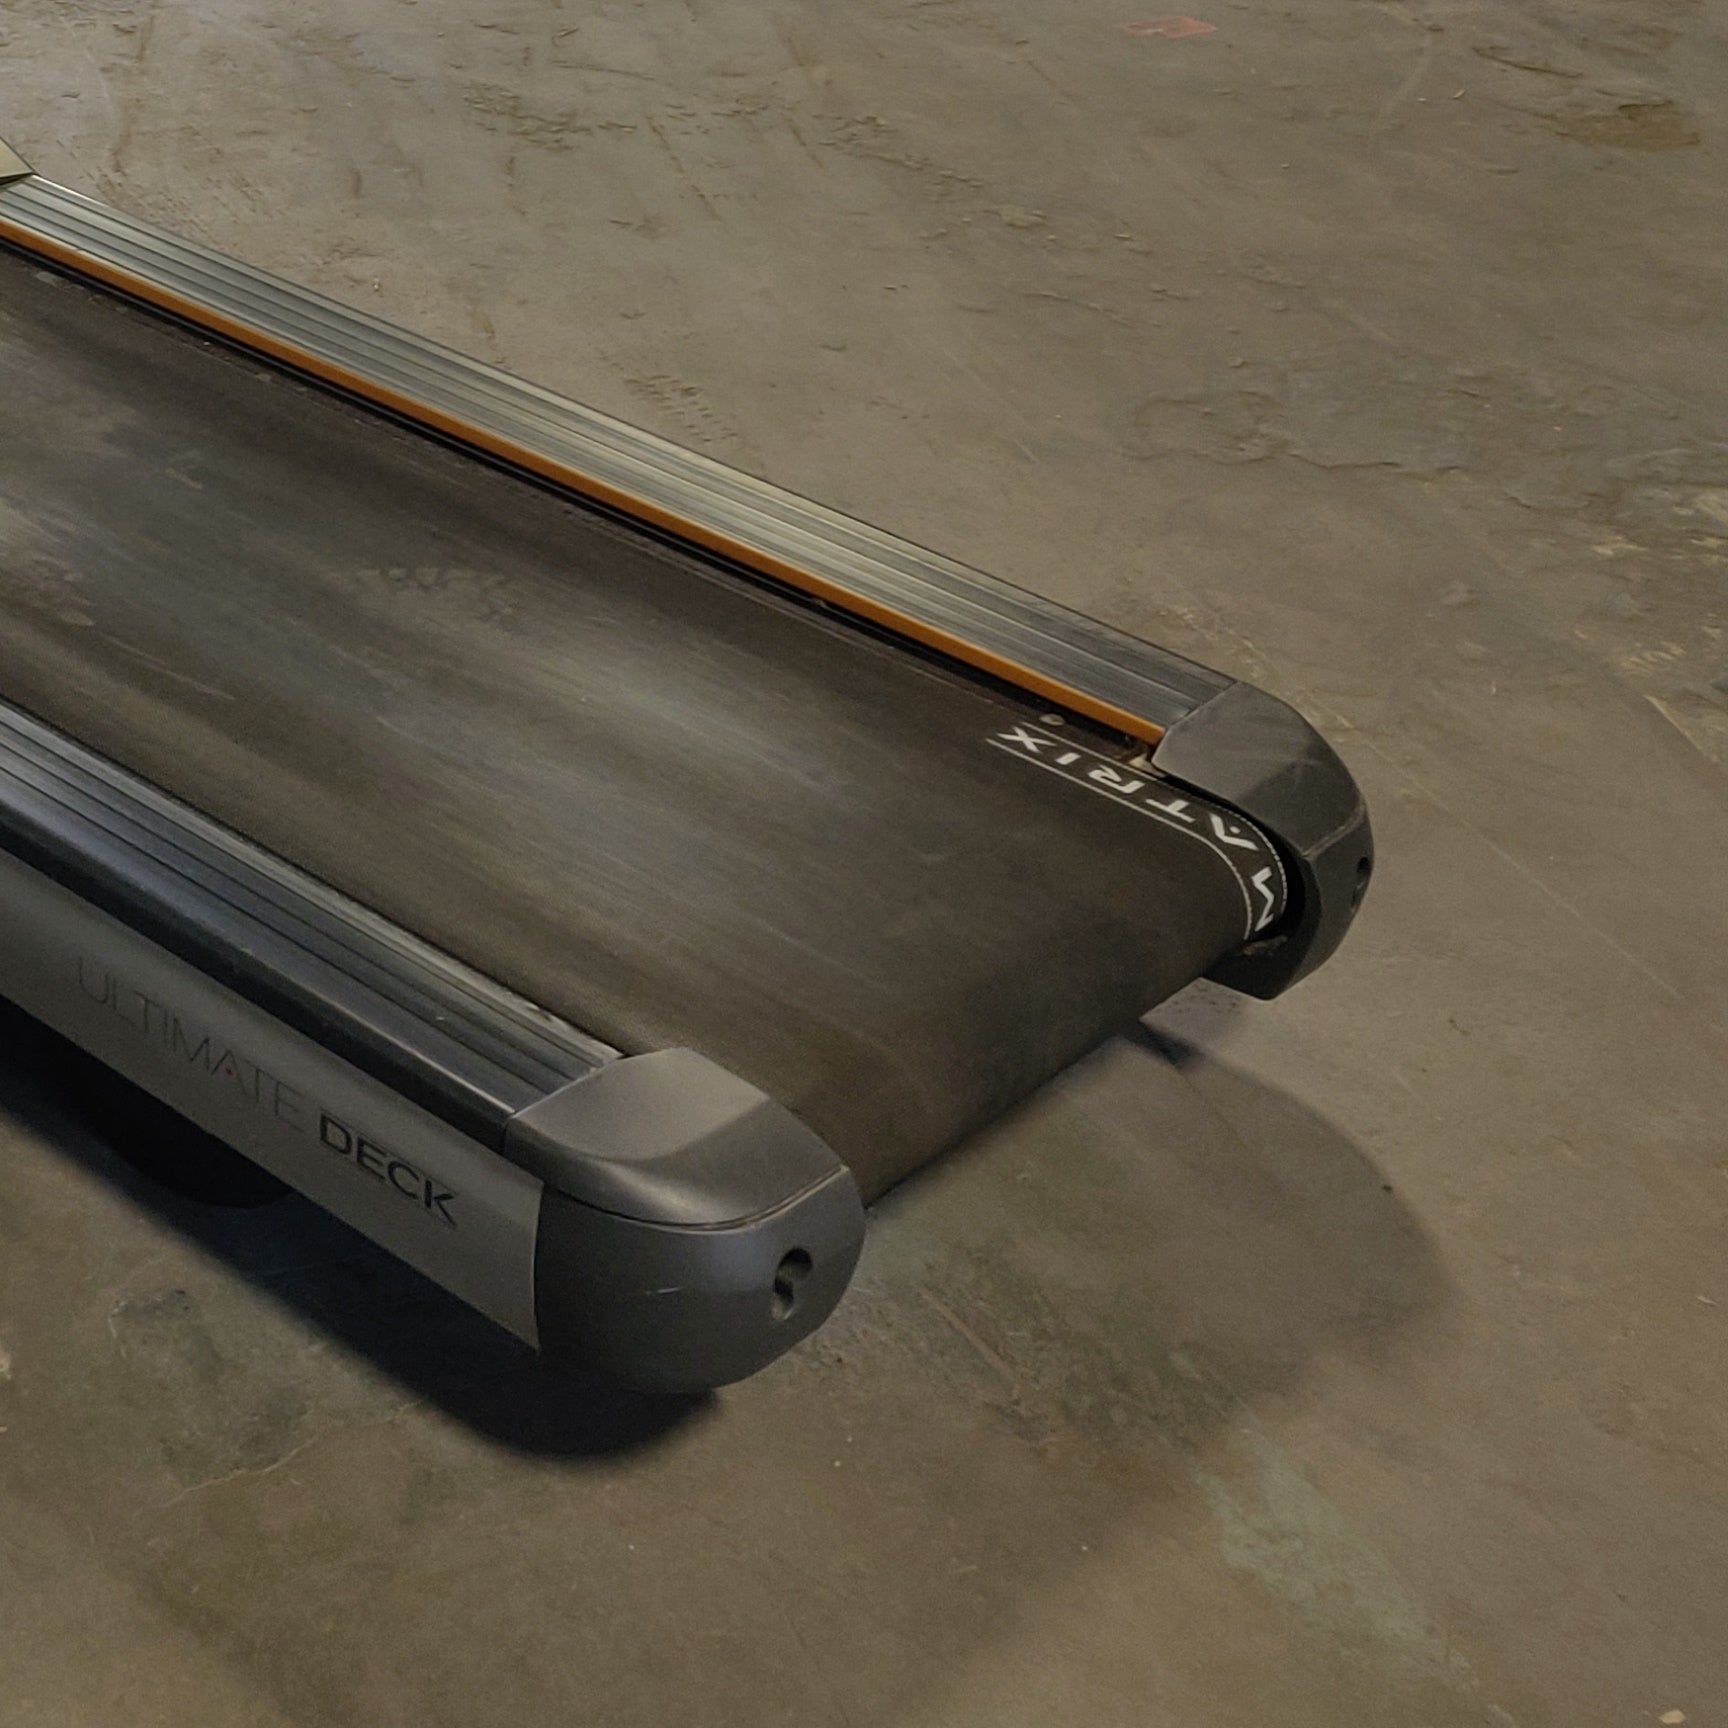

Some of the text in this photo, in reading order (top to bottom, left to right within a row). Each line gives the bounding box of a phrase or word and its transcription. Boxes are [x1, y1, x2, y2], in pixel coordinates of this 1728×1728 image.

[996, 725, 1275, 933] MATRIX
[77, 956, 459, 1228] ULTIMATE DECK
